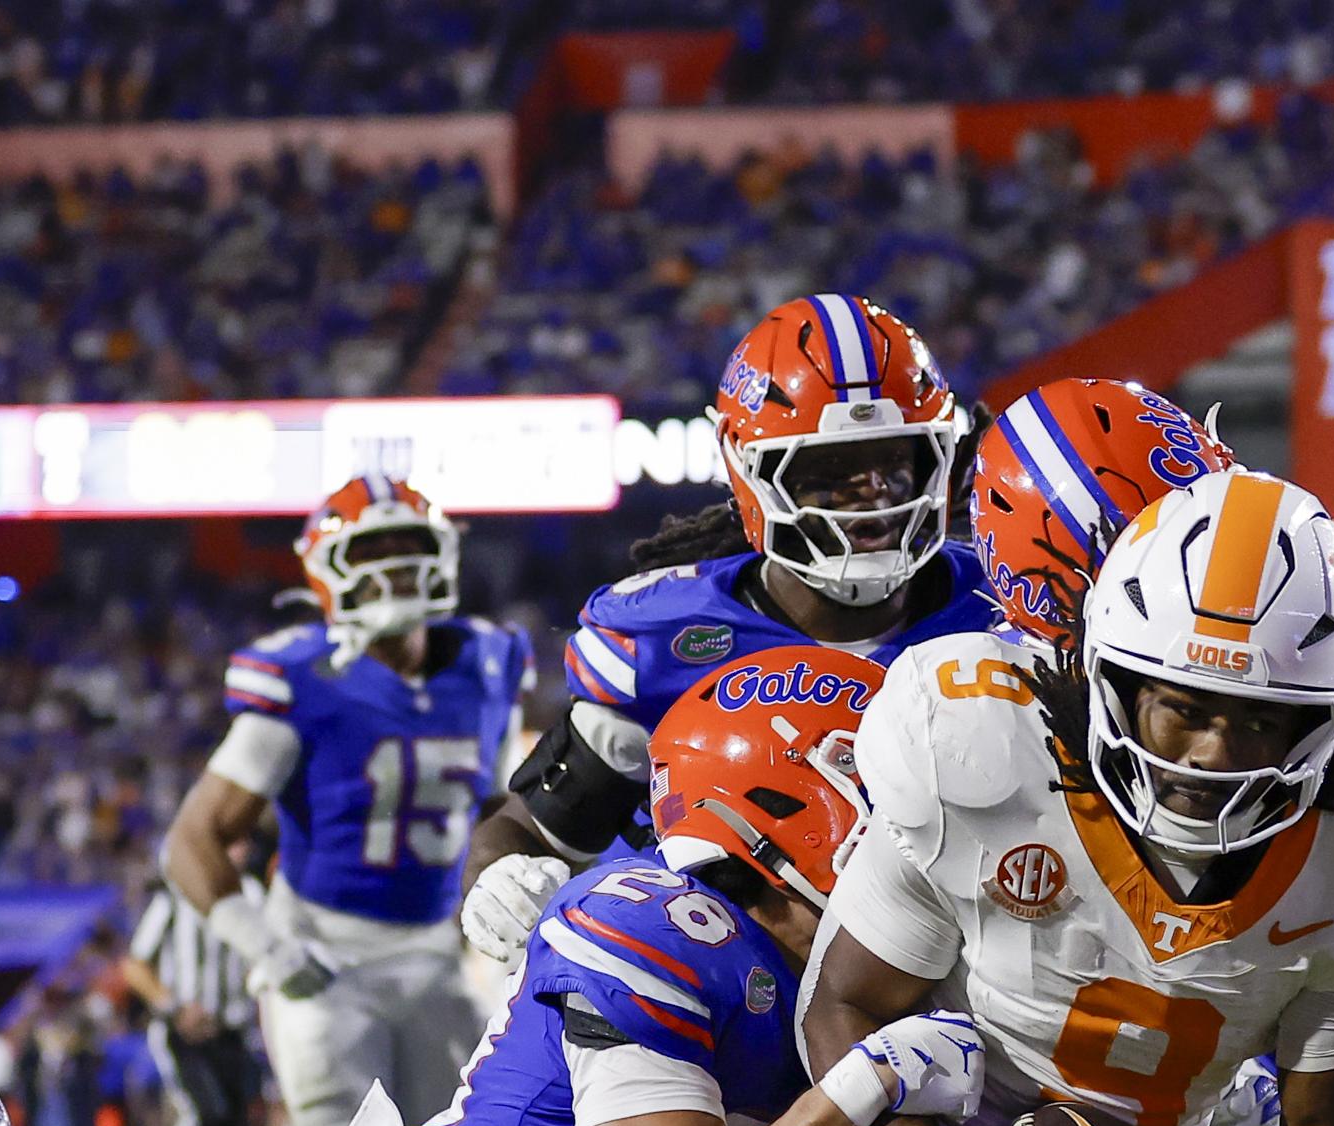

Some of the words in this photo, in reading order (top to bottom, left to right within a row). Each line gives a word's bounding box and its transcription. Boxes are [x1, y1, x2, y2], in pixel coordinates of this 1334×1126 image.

[936, 656, 1038, 706] 9
[1185, 641, 1251, 672] VOLS
[715, 661, 870, 713] Gator
[361, 737, 482, 868] 15
[1002, 847, 1060, 902] SEC
[1152, 911, 1192, 954] T
